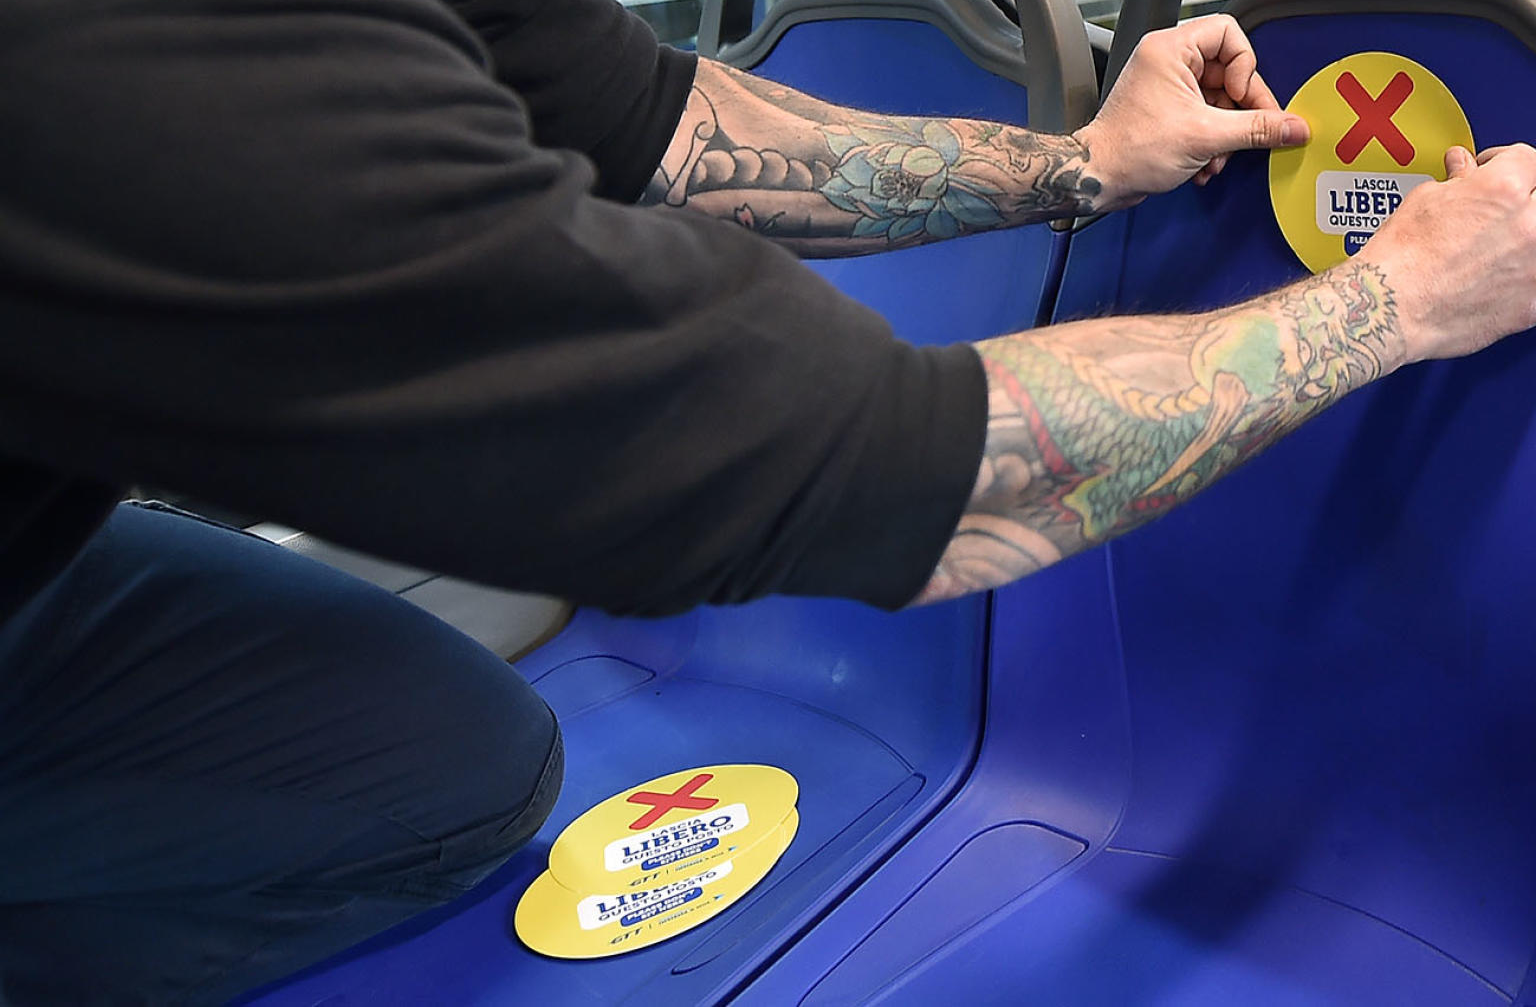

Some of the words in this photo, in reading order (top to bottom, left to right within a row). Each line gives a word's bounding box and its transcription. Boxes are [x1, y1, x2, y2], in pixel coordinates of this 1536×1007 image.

[1354, 178, 1400, 192] LASCIA
[1329, 190, 1403, 215] LIBER
[1329, 215, 1381, 228] QUESTO
[1350, 235, 1369, 245] PLEA
[621, 815, 732, 857] LIBERO
[651, 818, 702, 838] LASCIA
[622, 841, 683, 865] QUESTO
[686, 824, 735, 844] POSTO
[598, 893, 662, 922] QUESTO
[666, 870, 717, 895] POSTO
